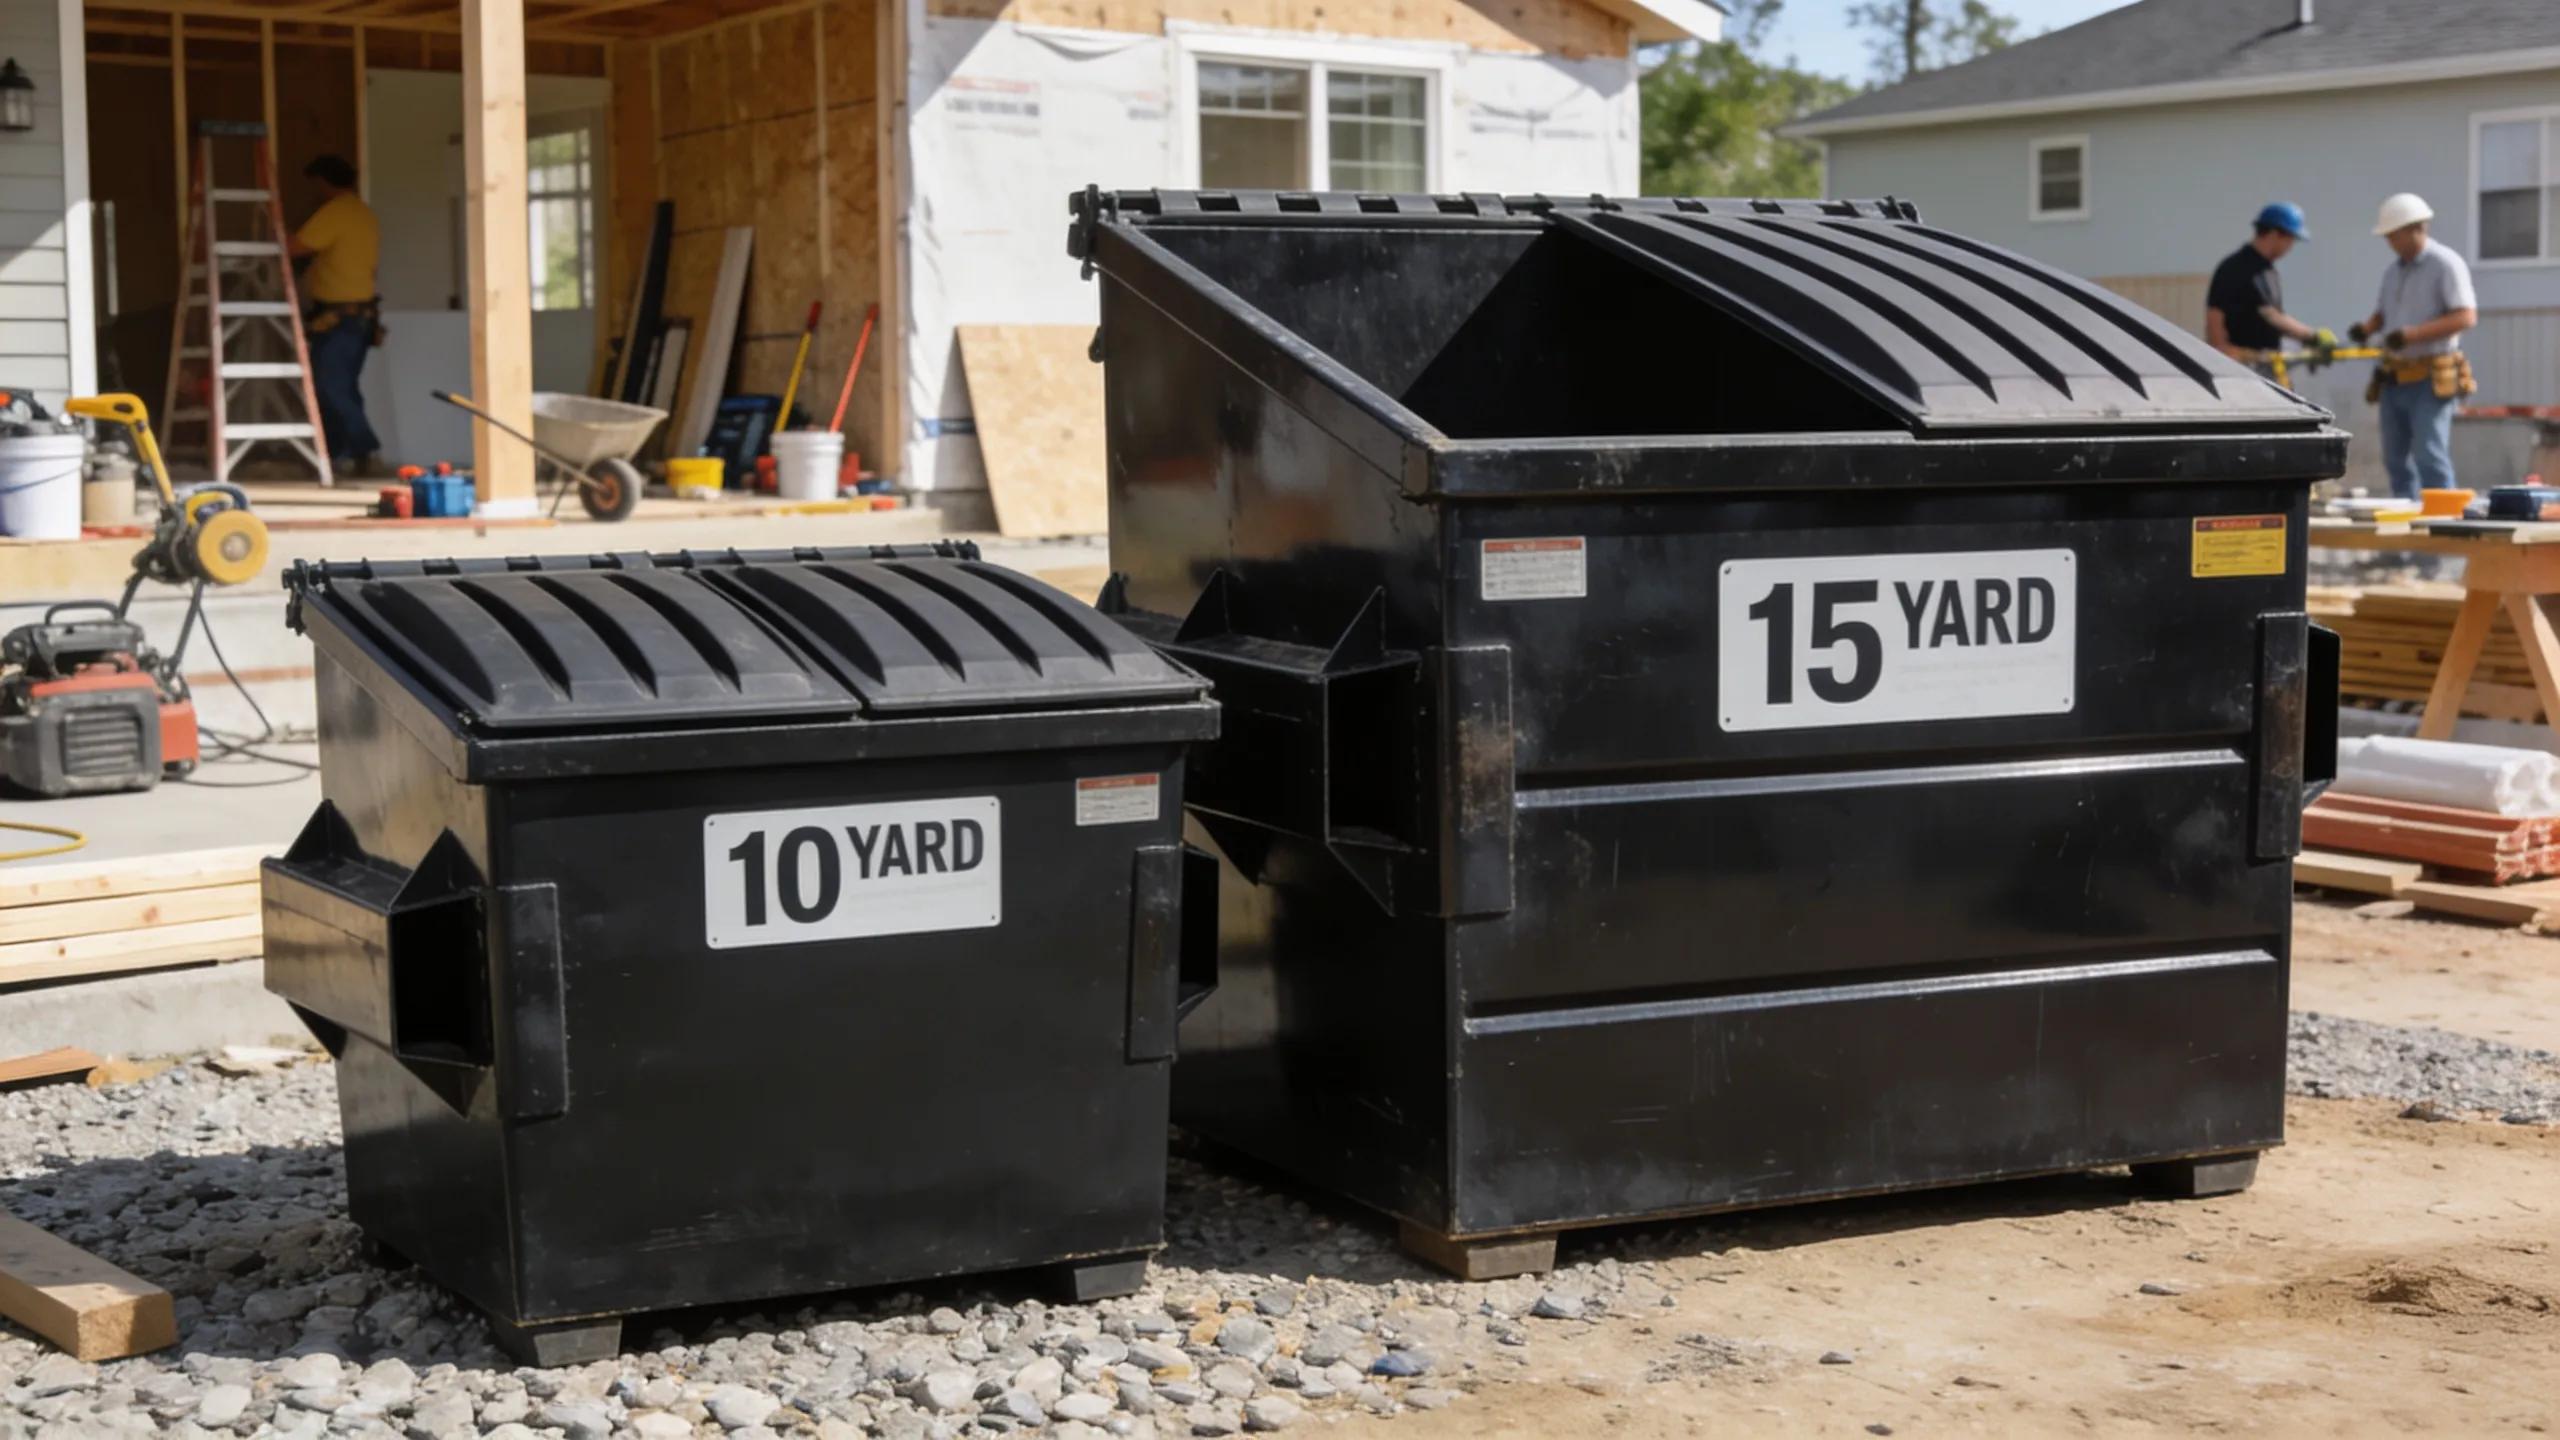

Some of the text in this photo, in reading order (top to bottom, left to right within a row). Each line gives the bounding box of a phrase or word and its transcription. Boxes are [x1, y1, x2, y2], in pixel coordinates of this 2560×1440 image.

[1748, 576, 2056, 705] 15 YARD
[728, 818, 984, 927] 10 YARD
